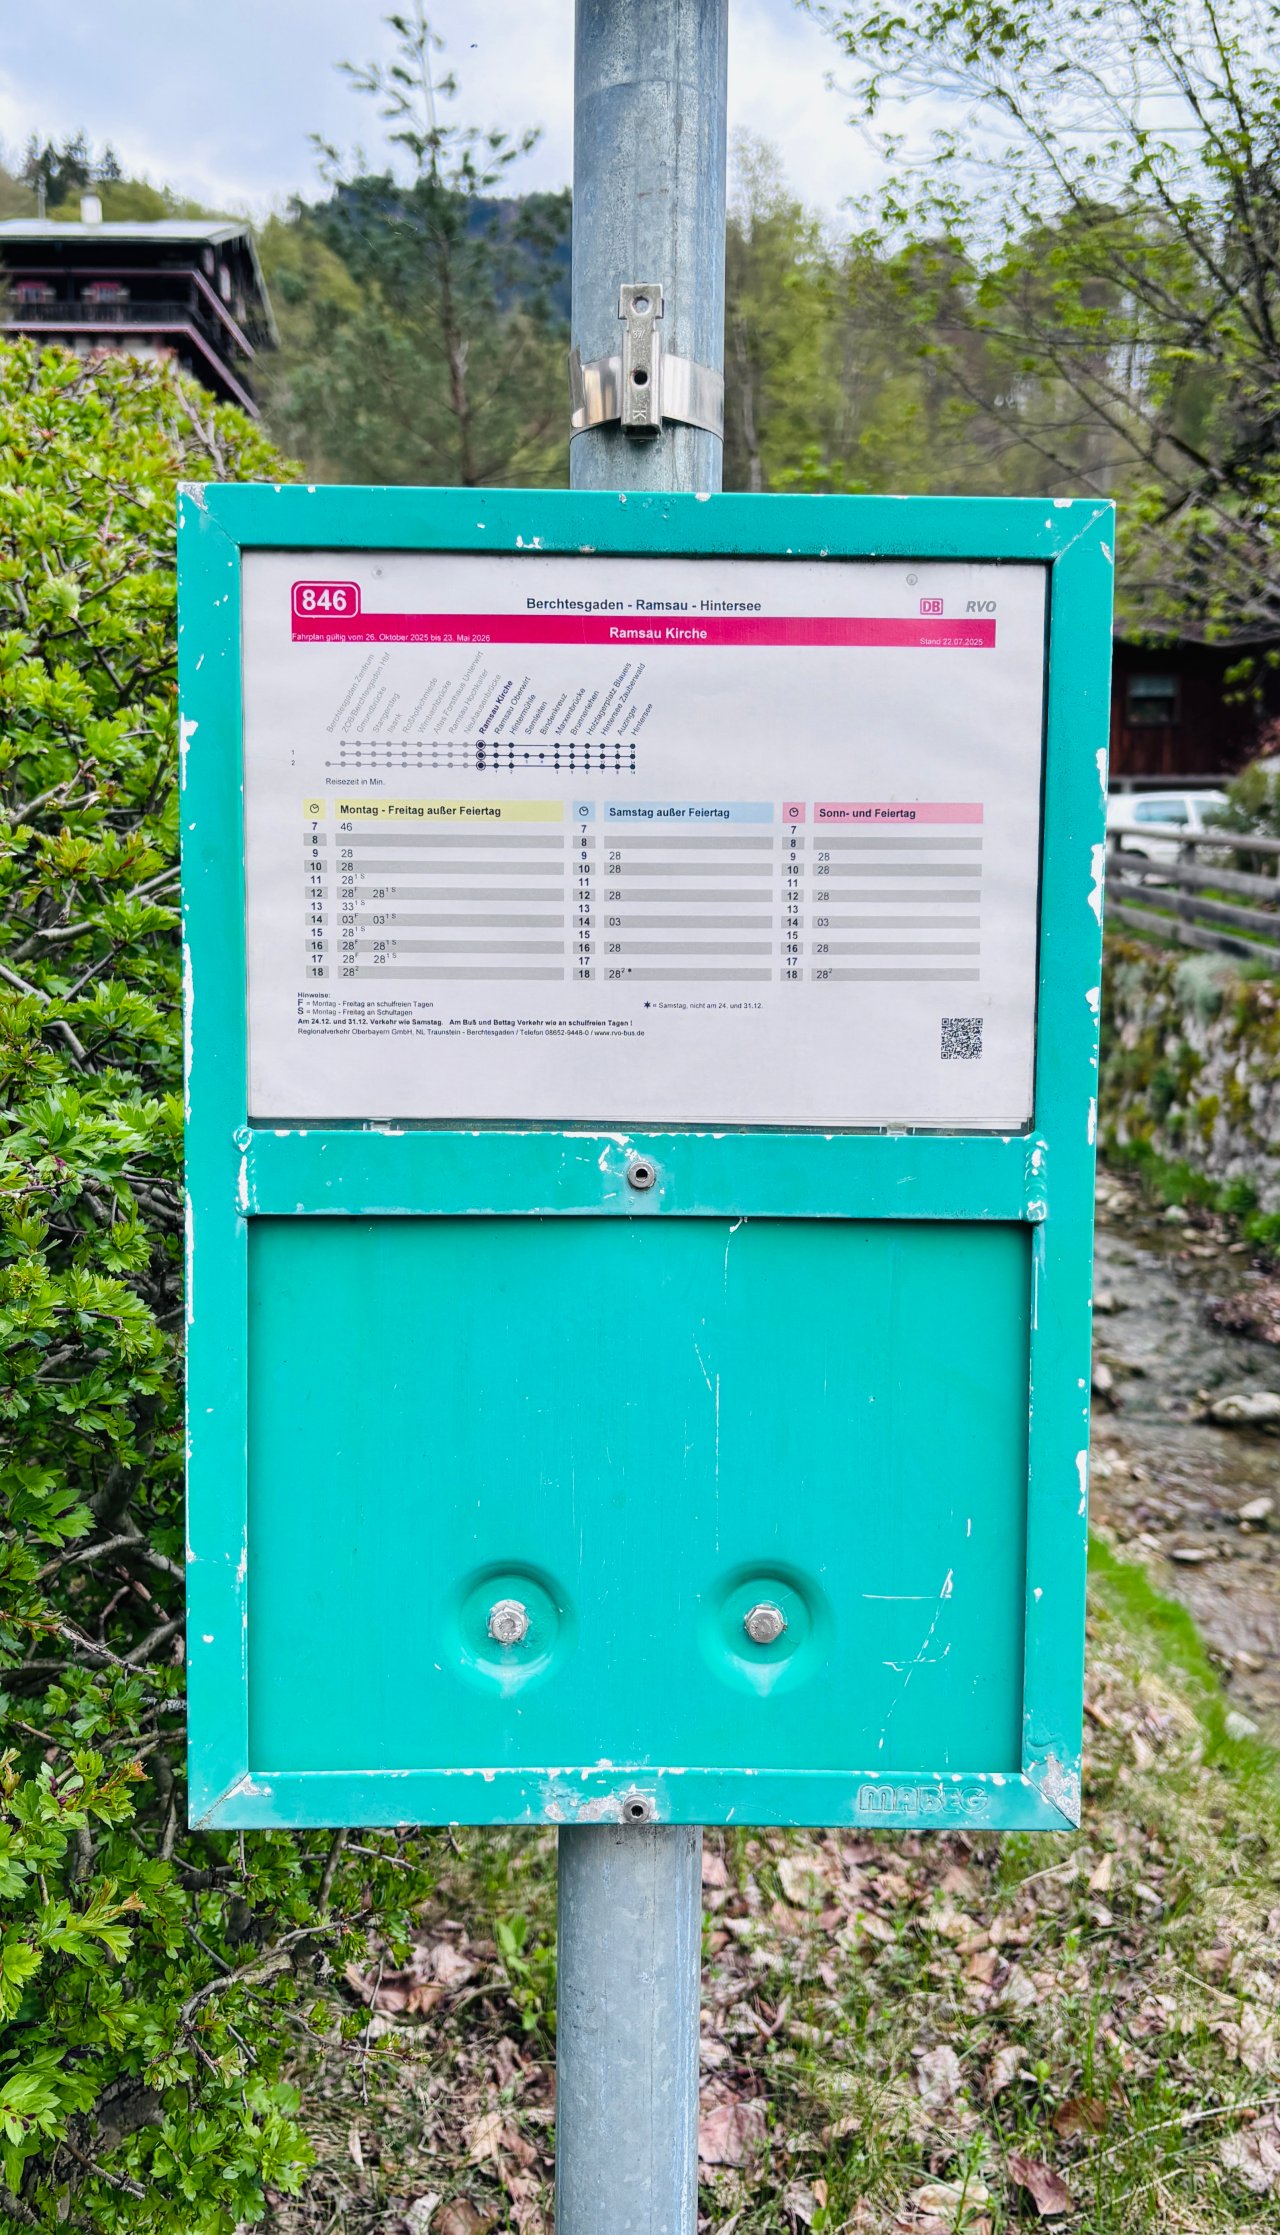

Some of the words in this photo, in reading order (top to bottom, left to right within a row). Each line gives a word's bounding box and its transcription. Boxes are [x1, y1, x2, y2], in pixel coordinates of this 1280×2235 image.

[302, 588, 347, 611] 846
[527, 598, 624, 613] Berchtesgaden
[636, 600, 688, 611] Ramsau
[700, 600, 762, 612] Hintersee
[922, 600, 942, 614] DB
[966, 601, 997, 613] RVO
[609, 627, 662, 639] Ramsau
[666, 628, 708, 639] Kirche
[292, 633, 324, 642] Fahrplan
[326, 633, 346, 643] gültig
[379, 633, 408, 642] Oktober
[410, 634, 428, 642] 2025
[430, 634, 440, 642] bis
[442, 634, 453, 642] 23.
[456, 634, 470, 642] Mai
[920, 637, 942, 646] Stand
[942, 637, 984, 646] 22.07.2025
[601, 702, 623, 736] Hintersee
[618, 662, 646, 703] Zauberwald
[479, 704, 499, 734] Ramsau
[496, 680, 513, 705] Kirche
[494, 706, 514, 734] Ramsau
[631, 703, 653, 736] Hintersee
[326, 778, 360, 786] Reisezeit
[340, 805, 379, 817] Montag
[388, 805, 424, 817] Freitag
[427, 806, 457, 815] außer
[460, 806, 501, 818] Feiertag
[610, 808, 654, 819] Samstag
[656, 808, 686, 817] außer
[689, 808, 730, 820] Feiertag
[819, 809, 850, 818] Sonn-
[852, 809, 872, 818] und
[874, 809, 916, 820] Feiertag
[312, 822, 318, 831] 7
[340, 822, 353, 832] 46
[581, 824, 587, 834] 7
[791, 826, 797, 835] 7
[312, 835, 318, 844] 8
[581, 838, 587, 847] 8
[790, 839, 796, 848] 8
[312, 849, 319, 858] 9
[341, 849, 353, 858] 28
[581, 851, 587, 860] 9
[609, 851, 621, 861] 28
[790, 852, 796, 861] 9
[818, 852, 830, 862] 28
[310, 862, 322, 871] 10
[342, 862, 354, 872] 28
[579, 865, 590, 874] 10
[609, 865, 622, 874] 28
[788, 866, 799, 874] 10
[818, 865, 830, 875] 28
[311, 875, 321, 884] 11
[579, 878, 589, 886] 11
[788, 878, 798, 887] 11
[311, 889, 323, 898] 12
[579, 891, 590, 900] 12
[609, 891, 621, 900] 28
[788, 892, 799, 900] 12
[818, 892, 830, 901] 28
[311, 902, 323, 911] 13
[579, 904, 590, 913] 13
[787, 905, 798, 914] 13
[312, 915, 323, 923] 14
[579, 918, 590, 926] 14
[609, 918, 622, 927] 03
[787, 918, 798, 927] 14
[817, 918, 829, 927] 03
[312, 928, 323, 937] 15
[579, 930, 590, 939] 15
[787, 931, 798, 940] 15
[312, 941, 323, 950] 16
[579, 944, 590, 952] 16
[609, 944, 621, 953] 28
[787, 944, 798, 953] 16
[817, 944, 829, 953] 28
[312, 954, 323, 963] 17
[579, 956, 590, 965] 17
[787, 957, 798, 966] 17
[312, 968, 324, 976] 18
[579, 970, 590, 978] 18
[786, 970, 798, 979] 18
[312, 1000, 336, 1008] Montag
[342, 1000, 365, 1008] Freitag
[342, 1009, 366, 1017] Freitag
[377, 1009, 413, 1017] Schultagen
[412, 1018, 444, 1027] Samstag.
[493, 1019, 516, 1028] Bettag
[608, 1020, 629, 1028] Tagen
[859, 1784, 989, 1814] MABEG
